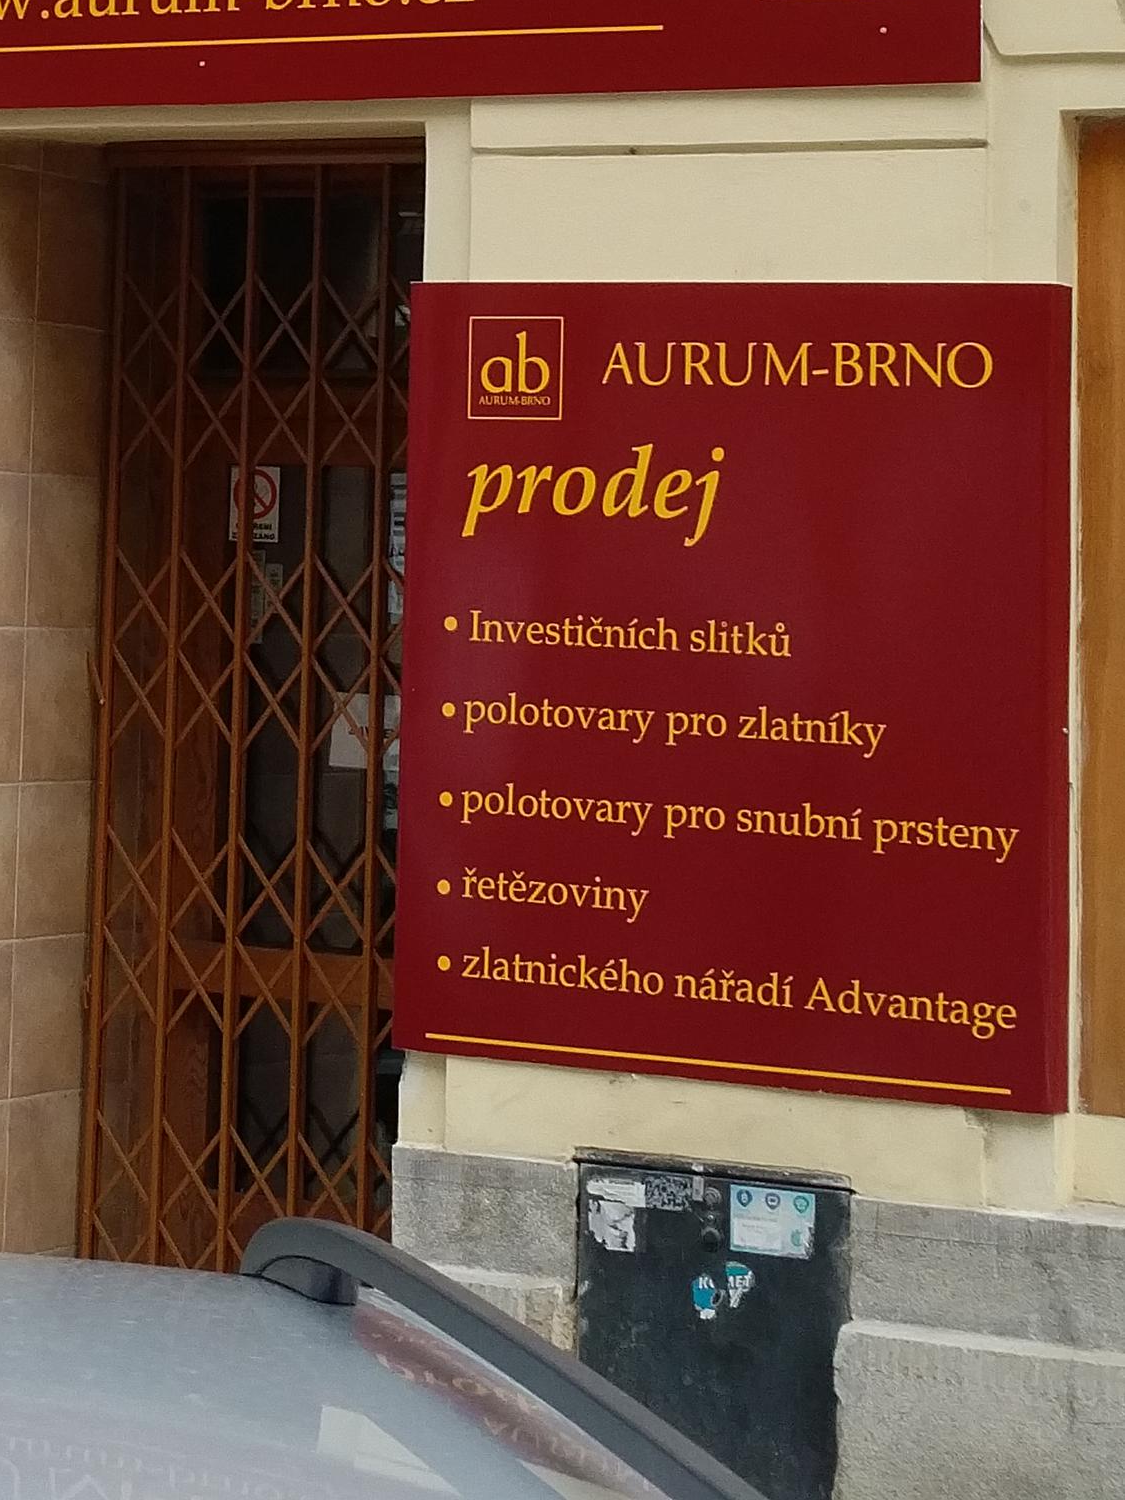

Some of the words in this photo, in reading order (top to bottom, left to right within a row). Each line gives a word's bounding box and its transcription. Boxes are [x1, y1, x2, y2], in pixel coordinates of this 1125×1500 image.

[481, 331, 549, 393] ab
[602, 342, 992, 388] AURUM-BRNO
[478, 395, 551, 406] AURUM-BRNO
[462, 444, 724, 546] prodej
[469, 610, 679, 651] Investičních
[690, 620, 791, 657] slitků
[463, 692, 655, 743] polotovary
[665, 712, 726, 746] pro
[738, 706, 886, 758] zlatníky
[461, 783, 653, 836] polotovary
[664, 805, 725, 838] pro
[737, 803, 862, 840] snubní
[873, 817, 1019, 863] prsteny
[462, 867, 649, 923] řetězoviny
[462, 946, 663, 995] zlatnického
[675, 969, 793, 1007] nářadí
[804, 978, 1016, 1039] Advantage
